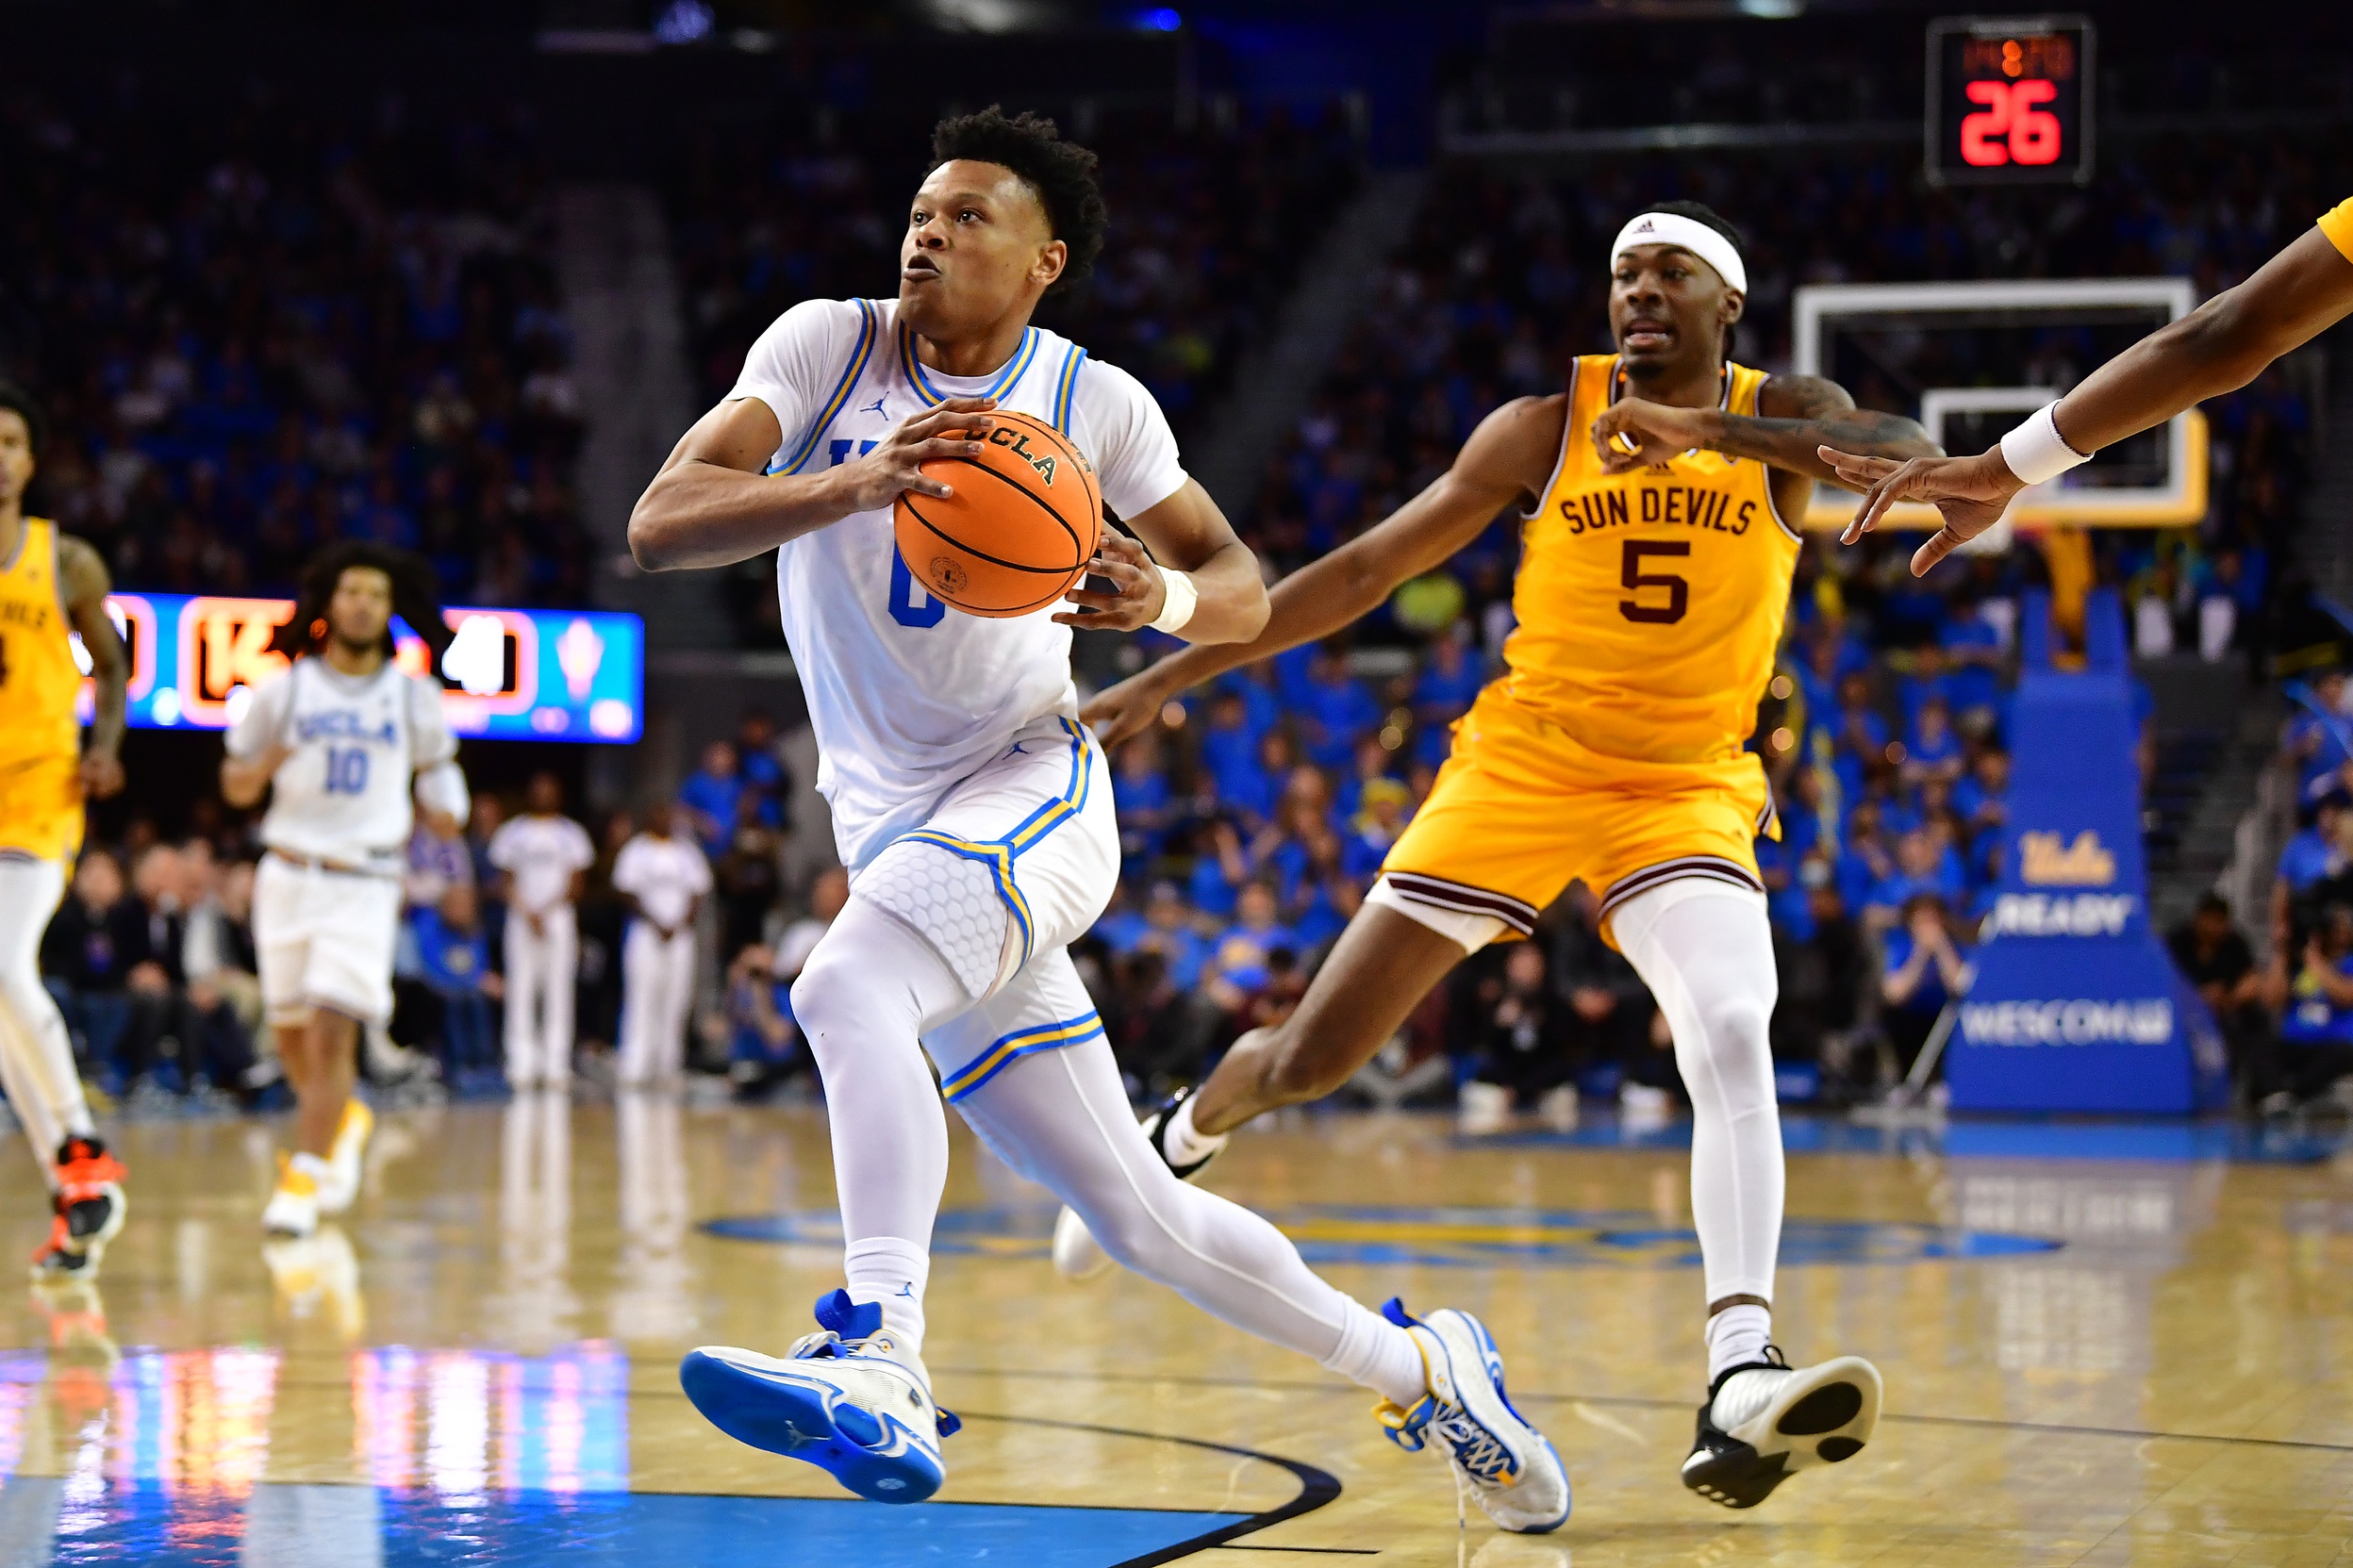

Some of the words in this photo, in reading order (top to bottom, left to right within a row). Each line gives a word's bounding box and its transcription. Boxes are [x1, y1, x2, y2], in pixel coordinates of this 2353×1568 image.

[1961, 79, 2061, 166] 26
[1561, 489, 1630, 535] SUN
[1642, 487, 1757, 536] DEVILS
[1618, 540, 1690, 624] 5
[297, 709, 397, 746] UCLA
[324, 746, 370, 795] 10
[1961, 998, 2129, 1048] WESCOM
